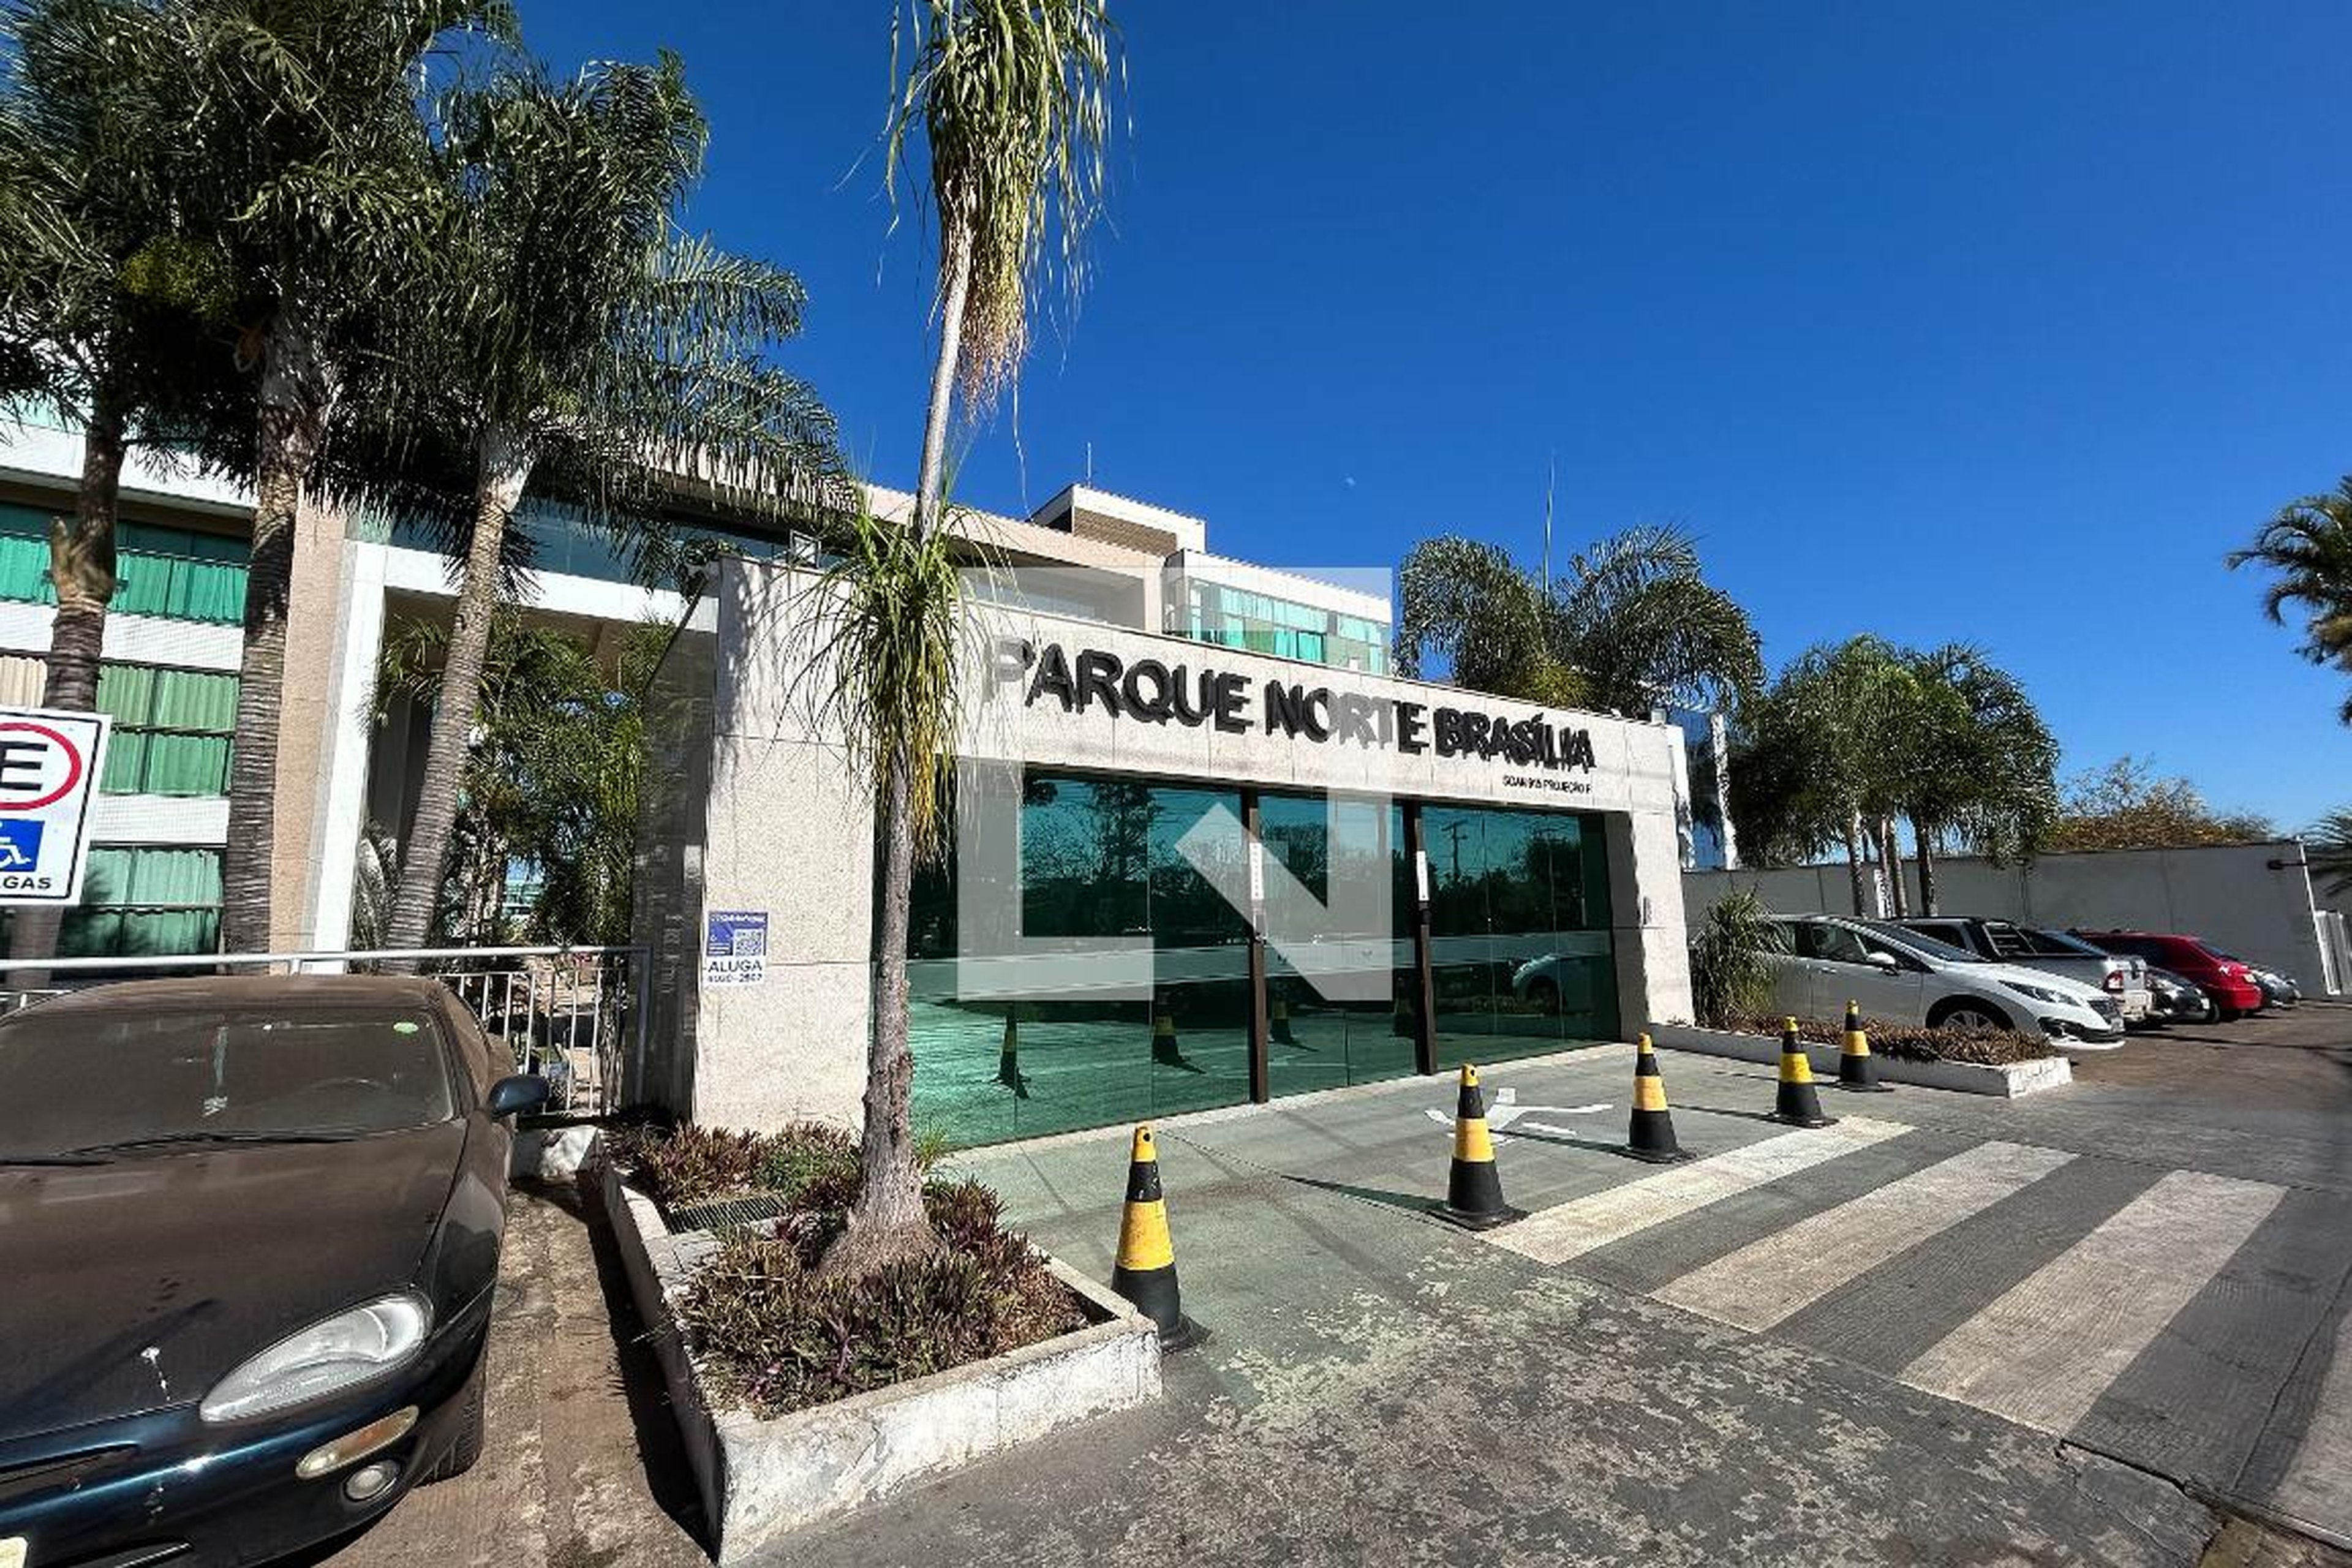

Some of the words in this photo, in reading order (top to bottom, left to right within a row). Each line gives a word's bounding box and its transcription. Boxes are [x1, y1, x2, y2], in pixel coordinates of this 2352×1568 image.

[982, 635, 1253, 734] PARQUE
[1264, 679, 1430, 755] NORTE
[1433, 712, 1596, 774] BRASÍLIA
[0, 875, 51, 889] GAS
[708, 959, 762, 973] ALUGA
